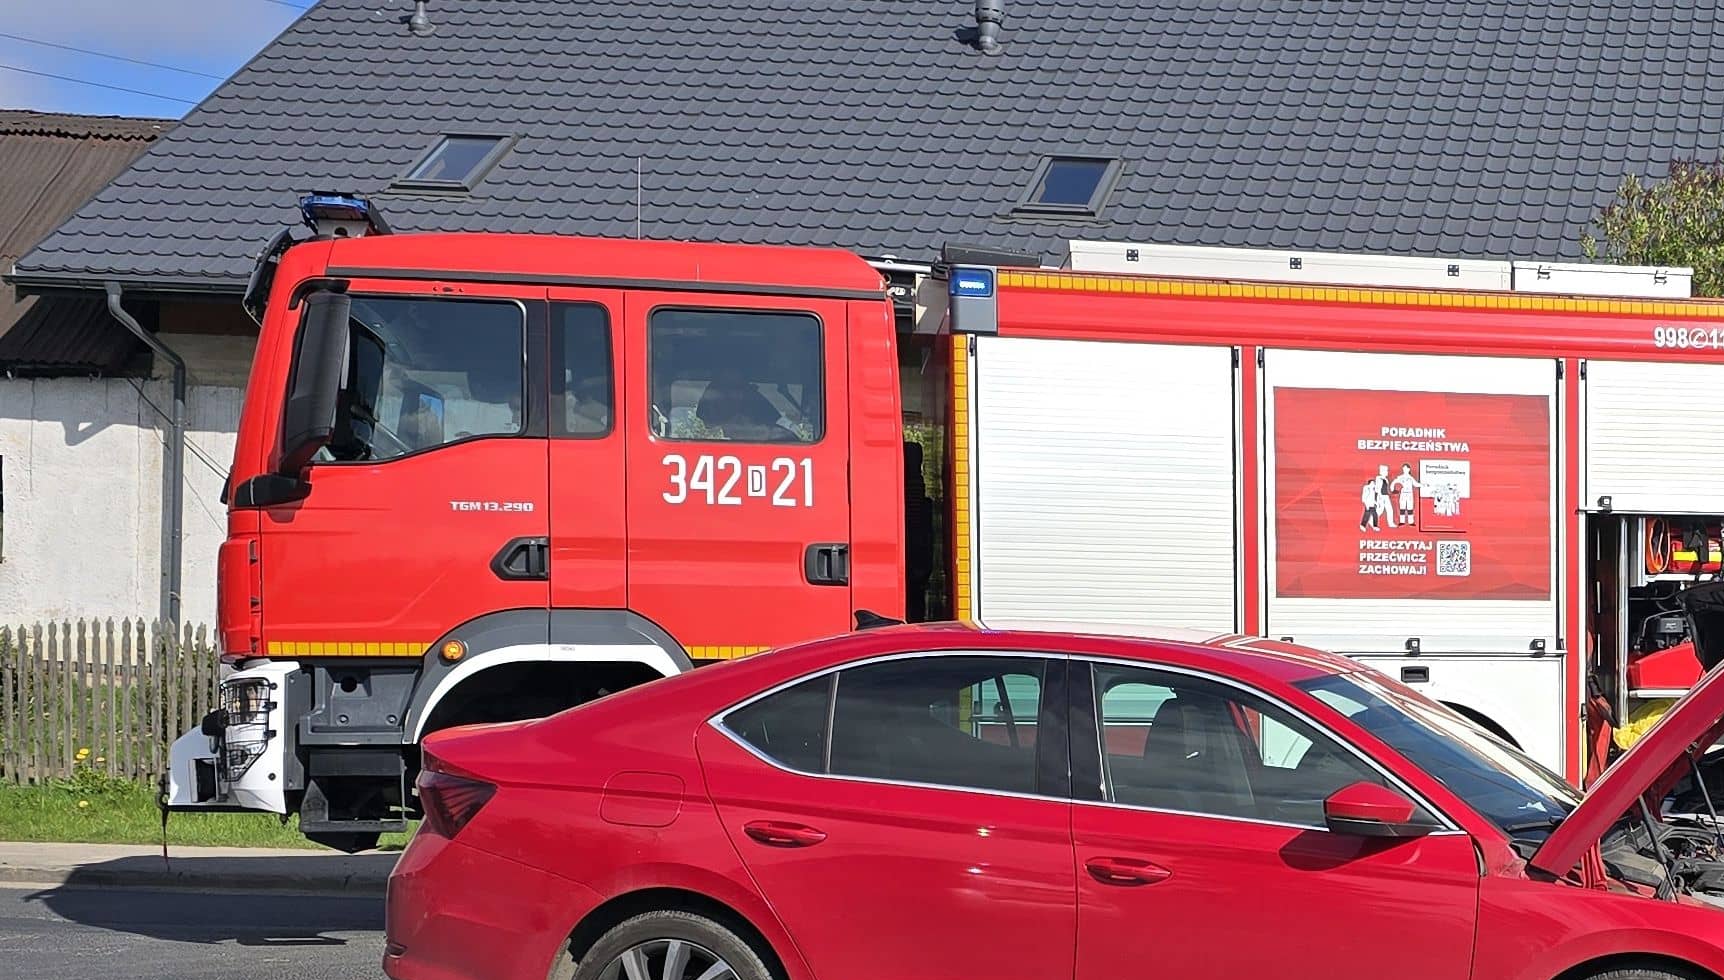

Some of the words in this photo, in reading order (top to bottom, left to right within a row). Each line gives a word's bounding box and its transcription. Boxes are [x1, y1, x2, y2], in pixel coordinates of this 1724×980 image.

[1654, 326, 1688, 348] 998
[1381, 426, 1446, 438] PORADNIK
[1357, 439, 1470, 453] BEZPIECZEŃSTWA
[450, 501, 481, 511] TGM
[482, 502, 534, 512] 13.290
[1359, 540, 1433, 551] PRZECZYTAJ
[1359, 551, 1427, 562] PRZEĆWICZ
[1358, 564, 1427, 575] ZACHOWAJ!
